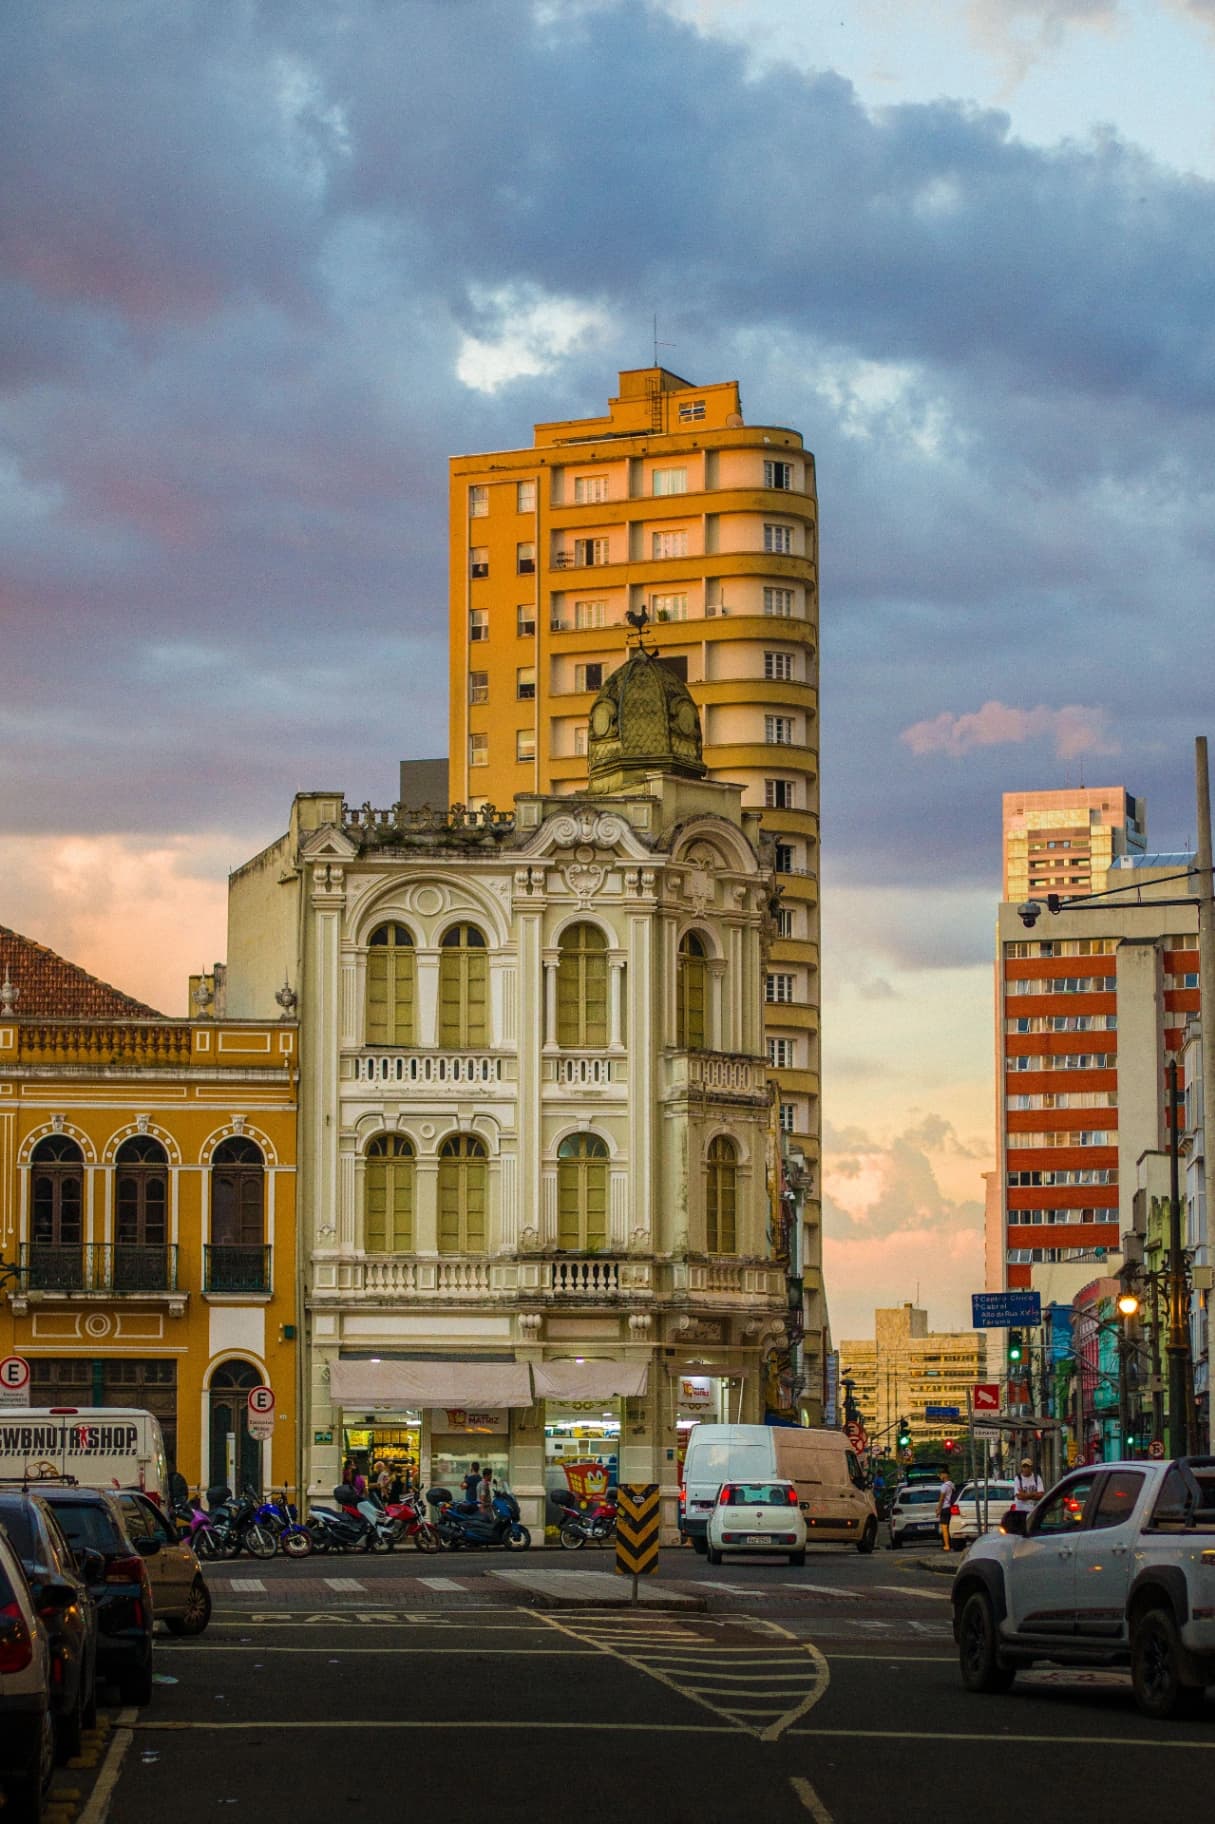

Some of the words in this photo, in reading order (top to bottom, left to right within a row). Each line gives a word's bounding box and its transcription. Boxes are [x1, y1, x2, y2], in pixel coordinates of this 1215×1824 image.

[8, 1364, 19, 1382] E
[257, 1392, 267, 1408] E
[469, 1416, 500, 1425] MATRIZ
[251, 1614, 452, 1623] PARE
